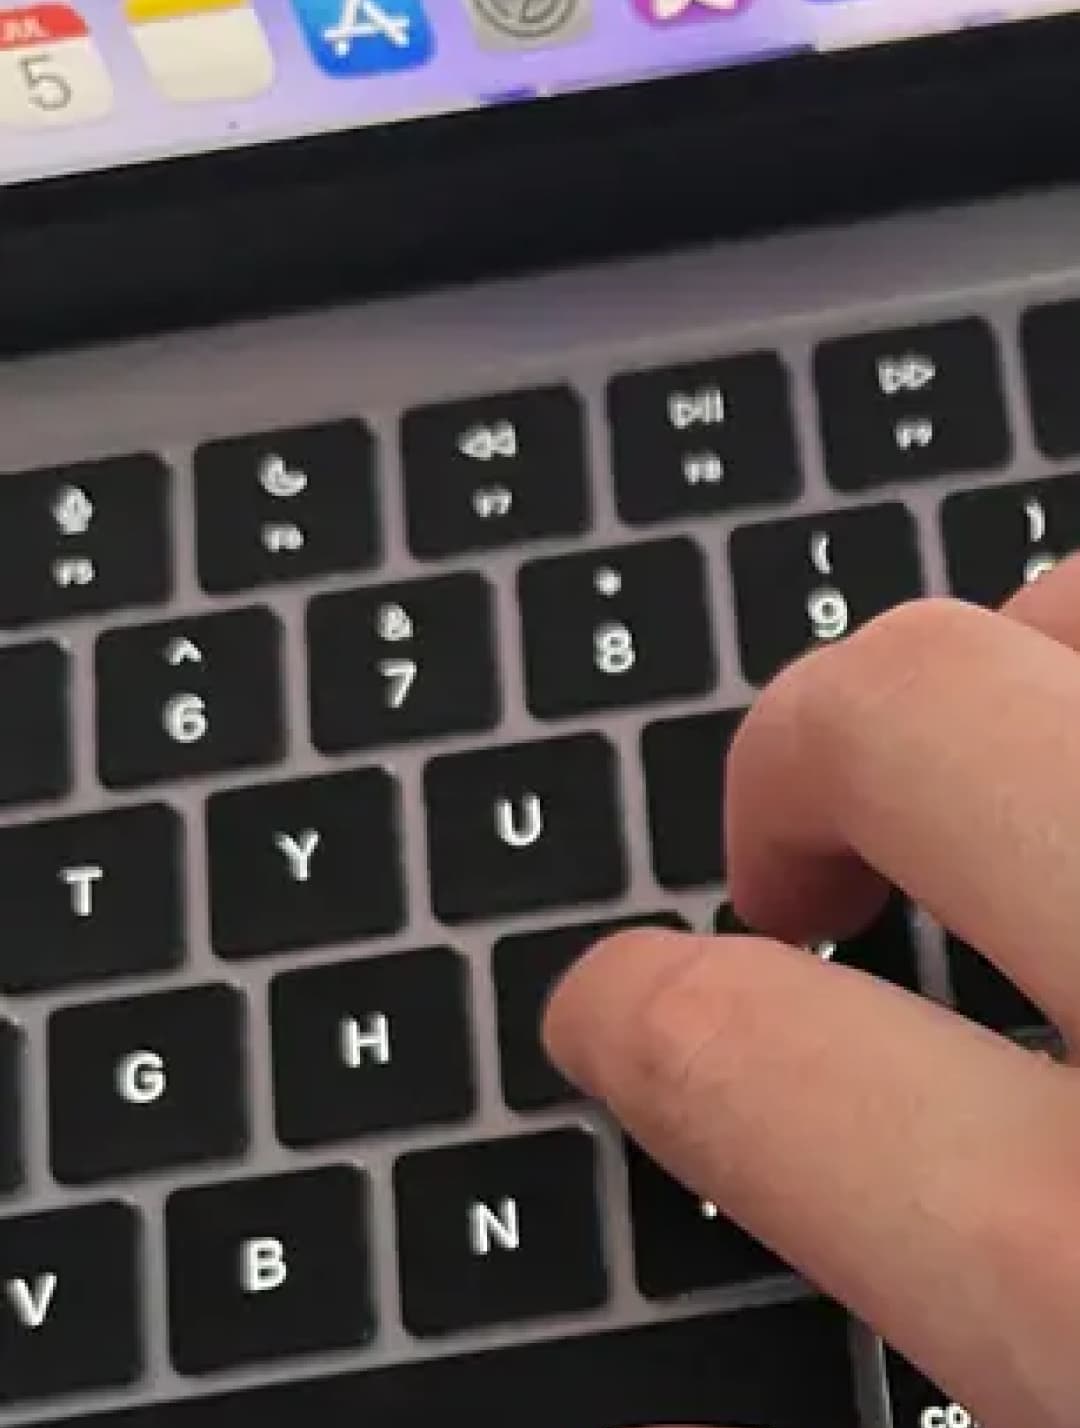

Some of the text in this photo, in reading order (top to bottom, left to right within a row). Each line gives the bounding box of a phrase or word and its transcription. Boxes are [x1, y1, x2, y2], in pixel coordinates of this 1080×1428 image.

[20, 54, 71, 109] 5
[808, 589, 848, 638] 9
[595, 624, 636, 673] 8
[380, 659, 417, 710] 7
[164, 693, 206, 744] 6
[497, 795, 542, 846] U
[277, 829, 319, 882] Y
[61, 866, 103, 917] T
[342, 1013, 390, 1069] H
[119, 1050, 166, 1104] G
[471, 1198, 520, 1255] N
[243, 1235, 288, 1292] B
[9, 1273, 57, 1327] V
